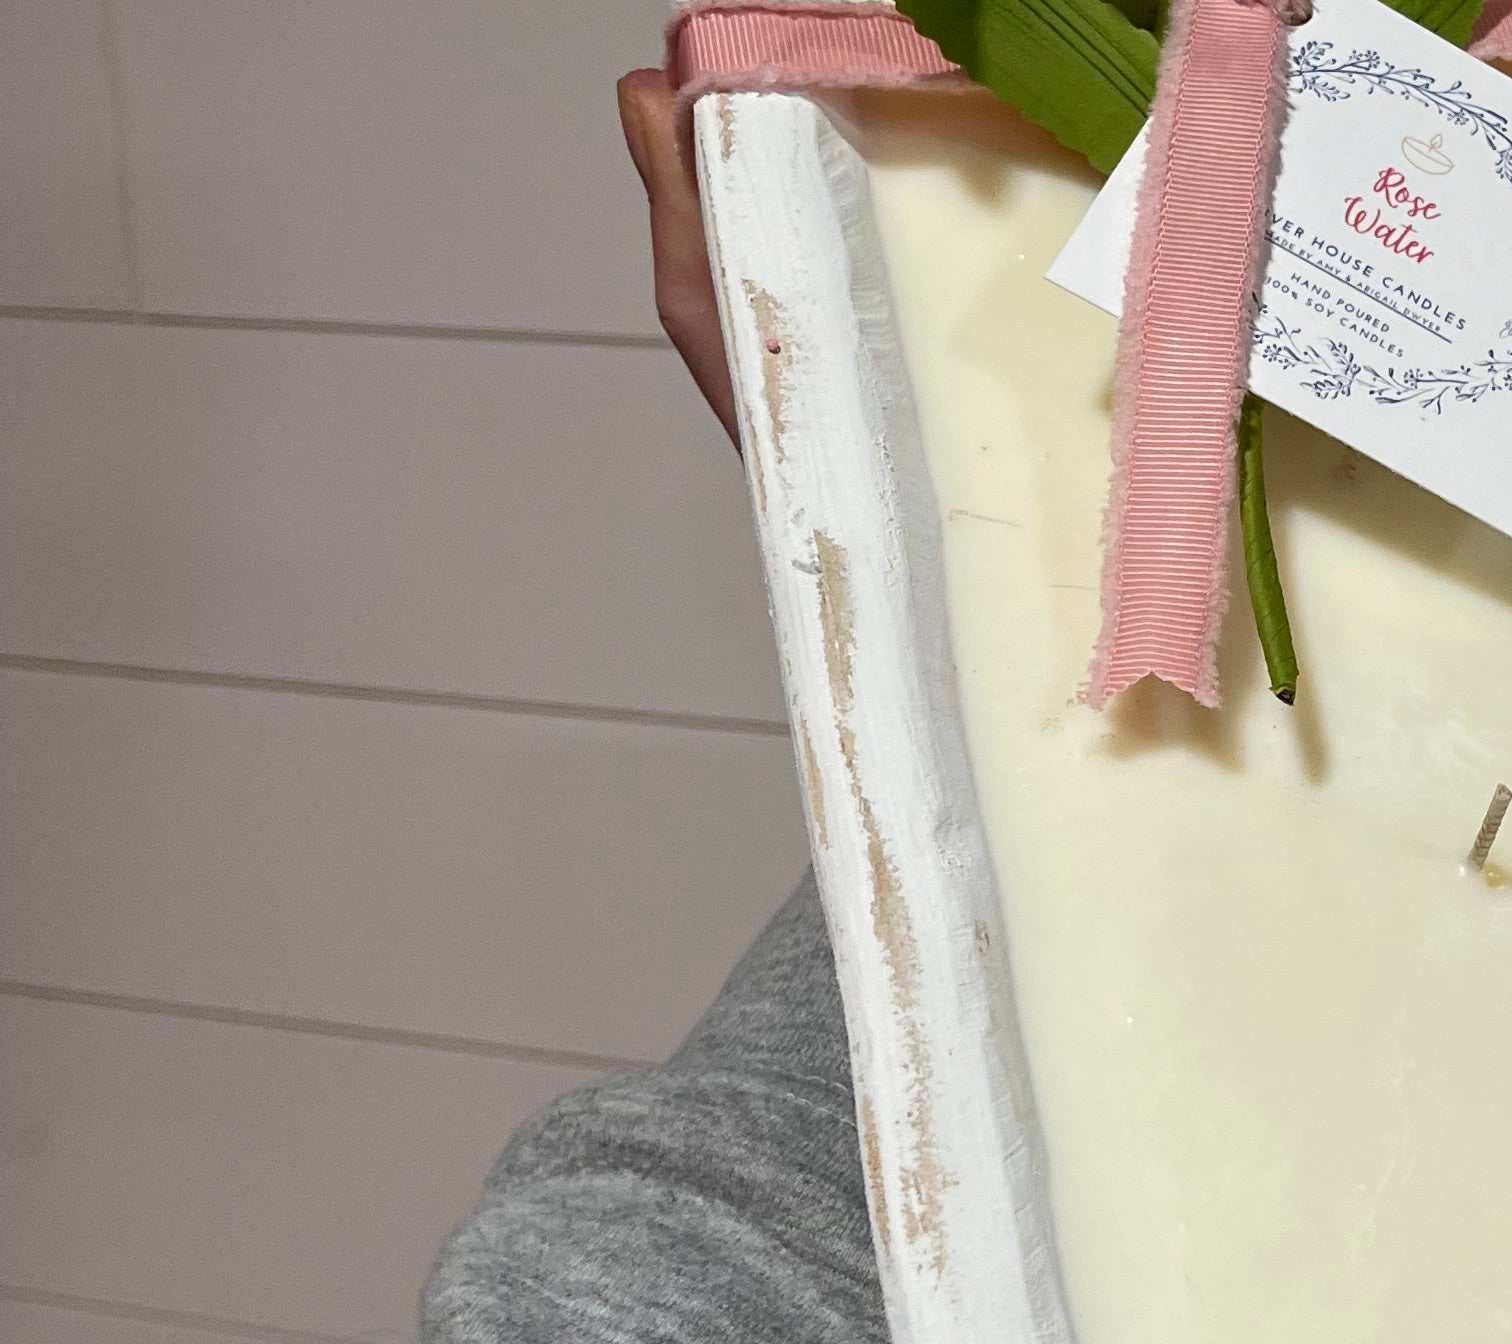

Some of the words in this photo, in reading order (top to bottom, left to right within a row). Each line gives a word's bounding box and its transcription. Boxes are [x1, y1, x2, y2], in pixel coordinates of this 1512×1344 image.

[1373, 167, 1442, 220] Rose
[1344, 197, 1434, 264] Water
[1312, 237, 1374, 278] HOUSE
[1382, 276, 1466, 331] CANDLES
[1317, 259, 1342, 276] AMY
[1291, 273, 1331, 300] HAND
[1336, 298, 1391, 333] POURED
[1305, 298, 1335, 319] SOY
[1339, 317, 1405, 358] CANDLES
